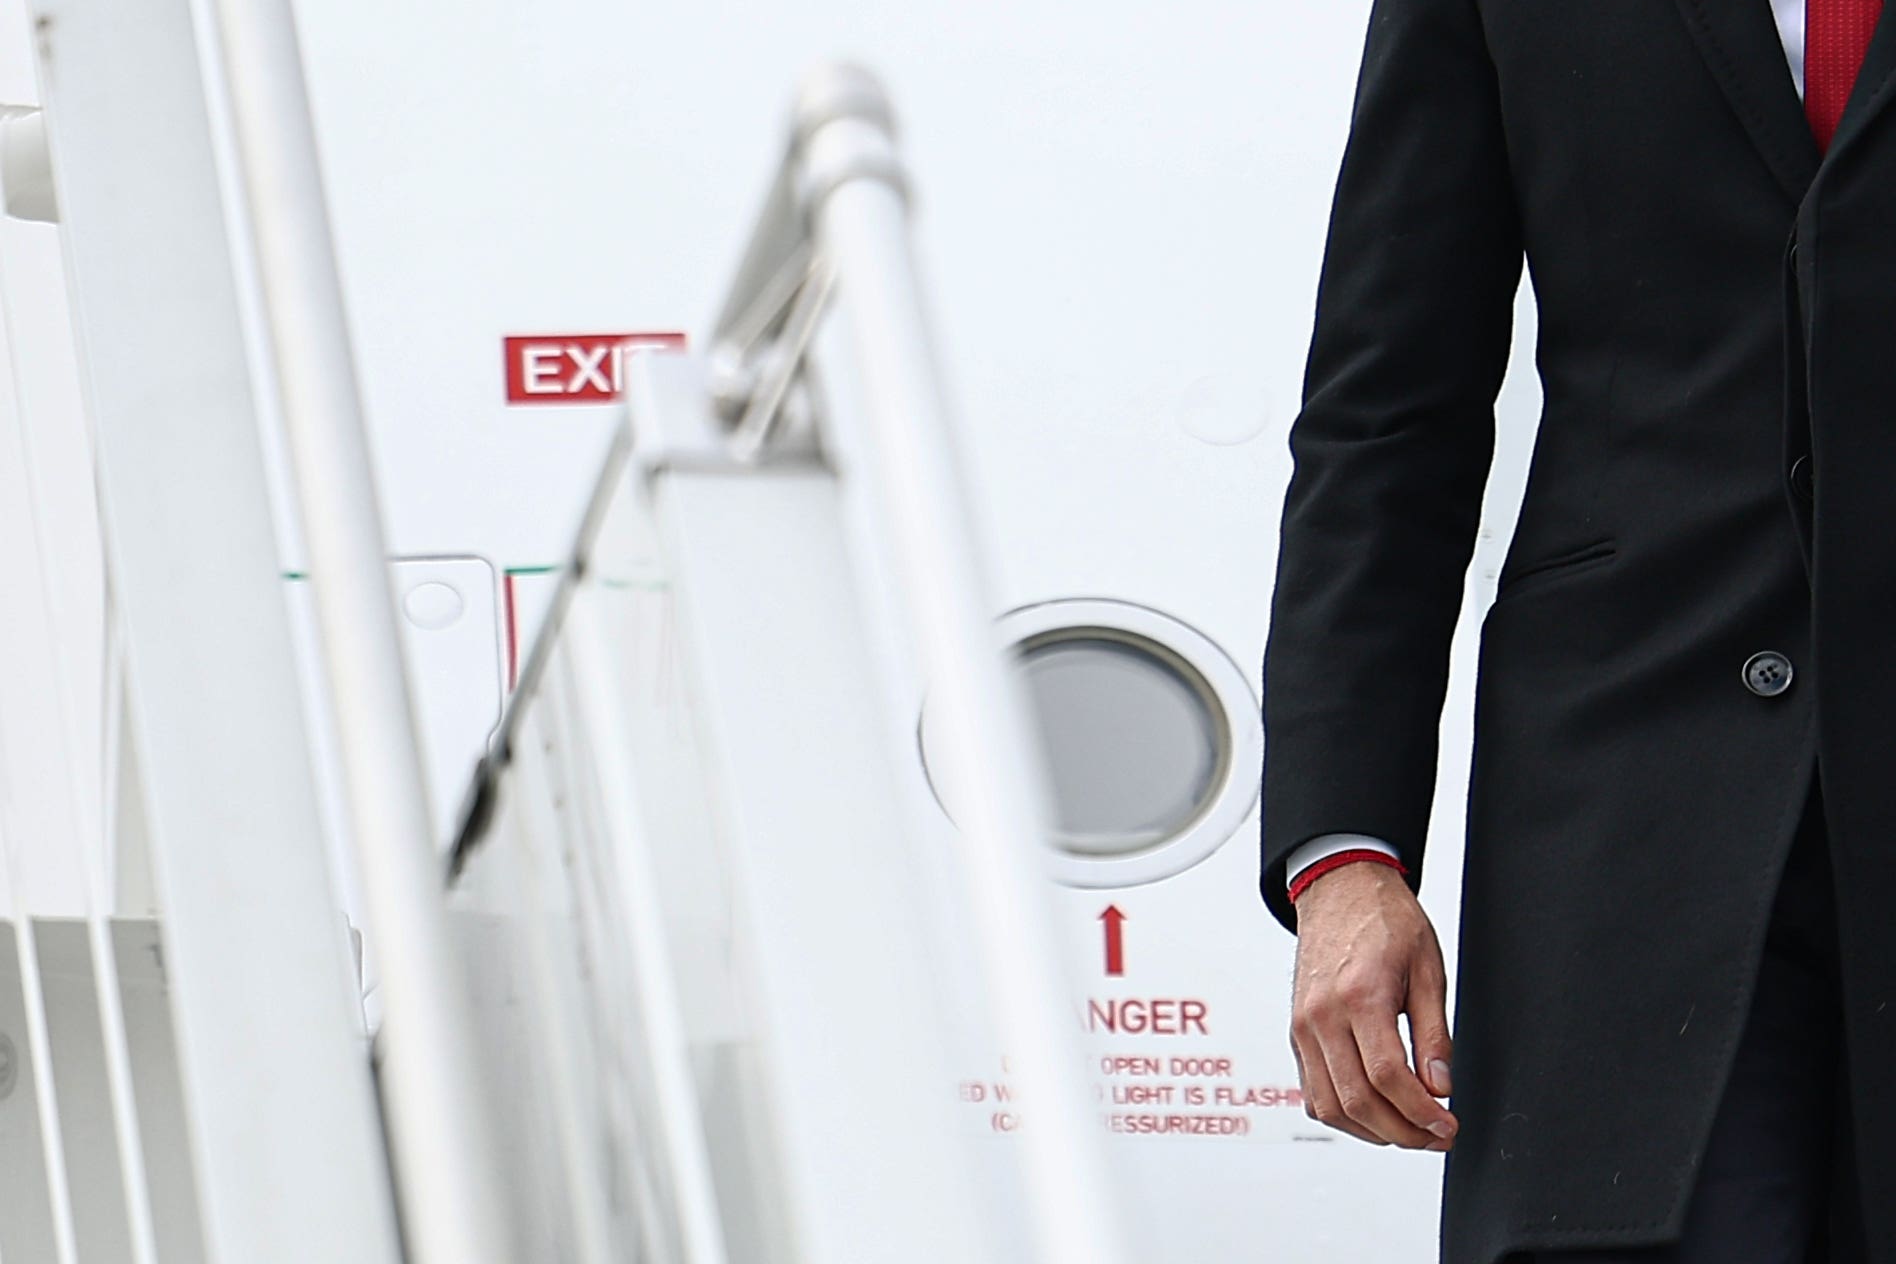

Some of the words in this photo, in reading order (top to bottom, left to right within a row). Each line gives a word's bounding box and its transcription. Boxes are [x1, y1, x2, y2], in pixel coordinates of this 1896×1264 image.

[521, 345, 640, 394] EXI
[1074, 999, 1209, 1036] NGER
[1100, 1057, 1161, 1076] OPEN
[1170, 1058, 1232, 1077] DOOR
[1112, 1086, 1174, 1105] LIGHT
[1184, 1087, 1205, 1105] IS
